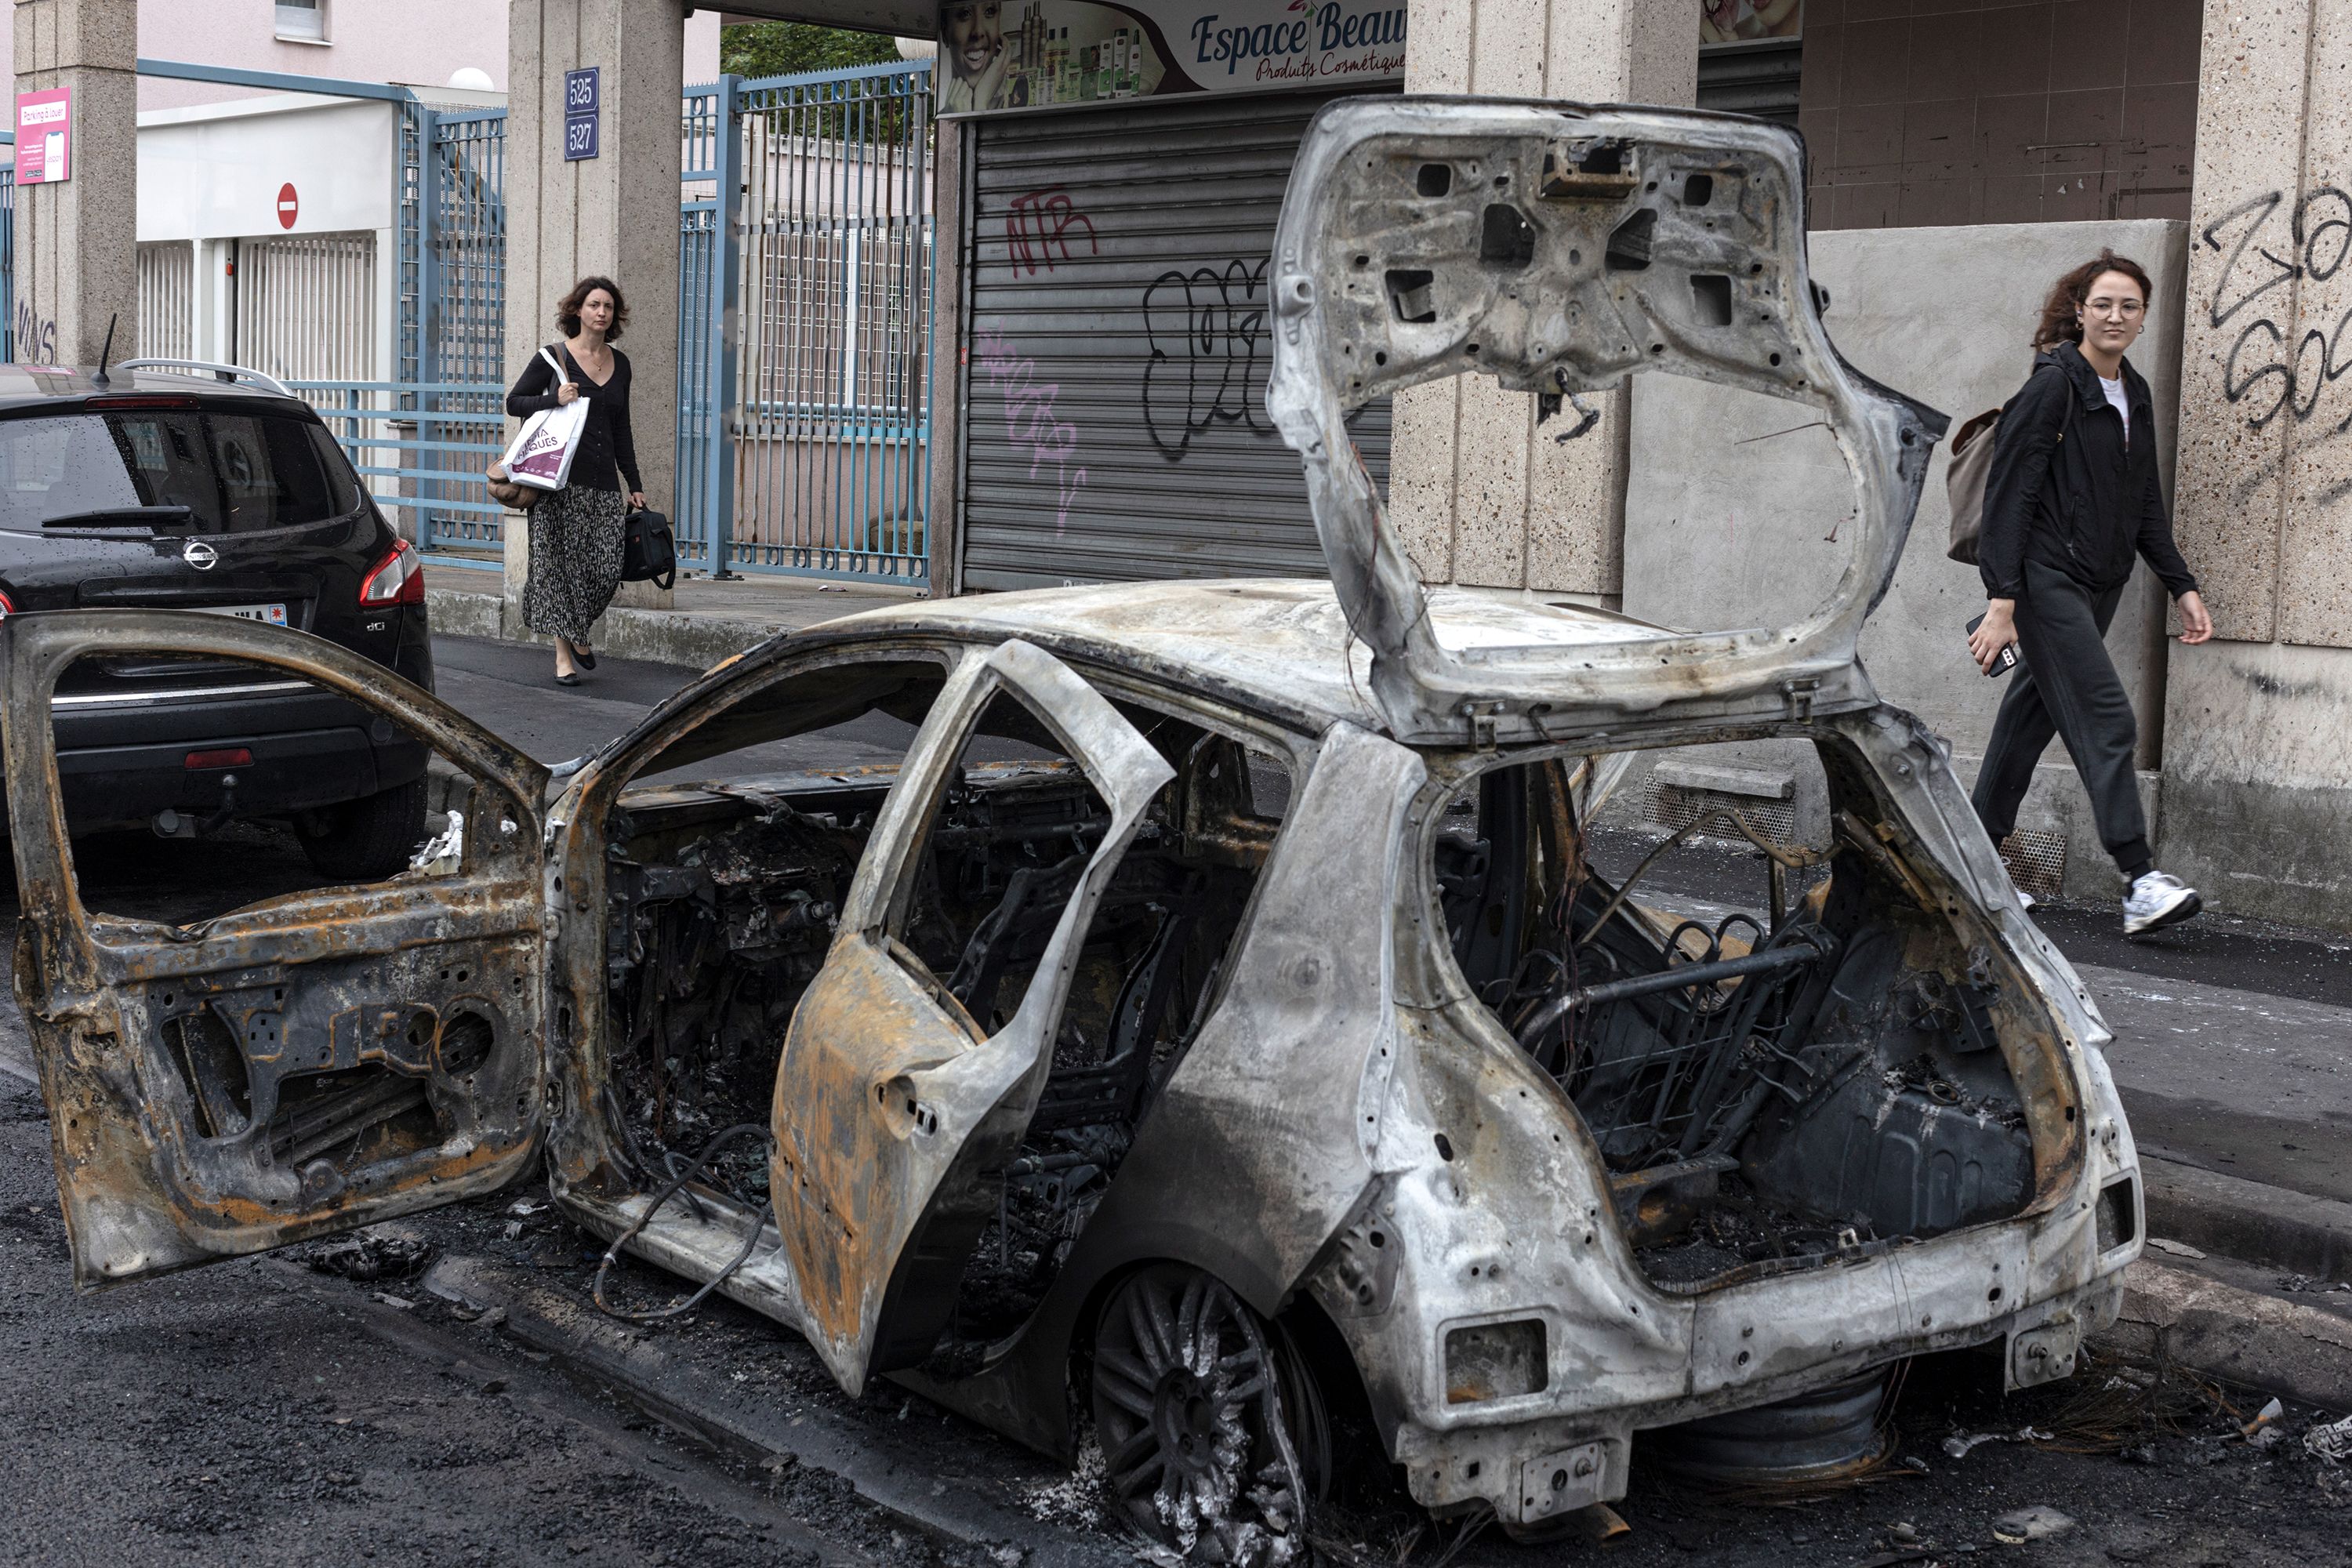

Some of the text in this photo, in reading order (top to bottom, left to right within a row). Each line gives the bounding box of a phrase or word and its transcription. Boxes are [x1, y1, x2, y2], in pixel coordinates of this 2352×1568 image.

[1191, 2, 1407, 74] Espace Beau
[1256, 57, 1317, 82] Produits
[570, 77, 592, 106] 525
[24, 109, 44, 122] Parking
[50, 107, 64, 118] louer
[570, 122, 592, 151] 527
[366, 622, 385, 632] dCi
